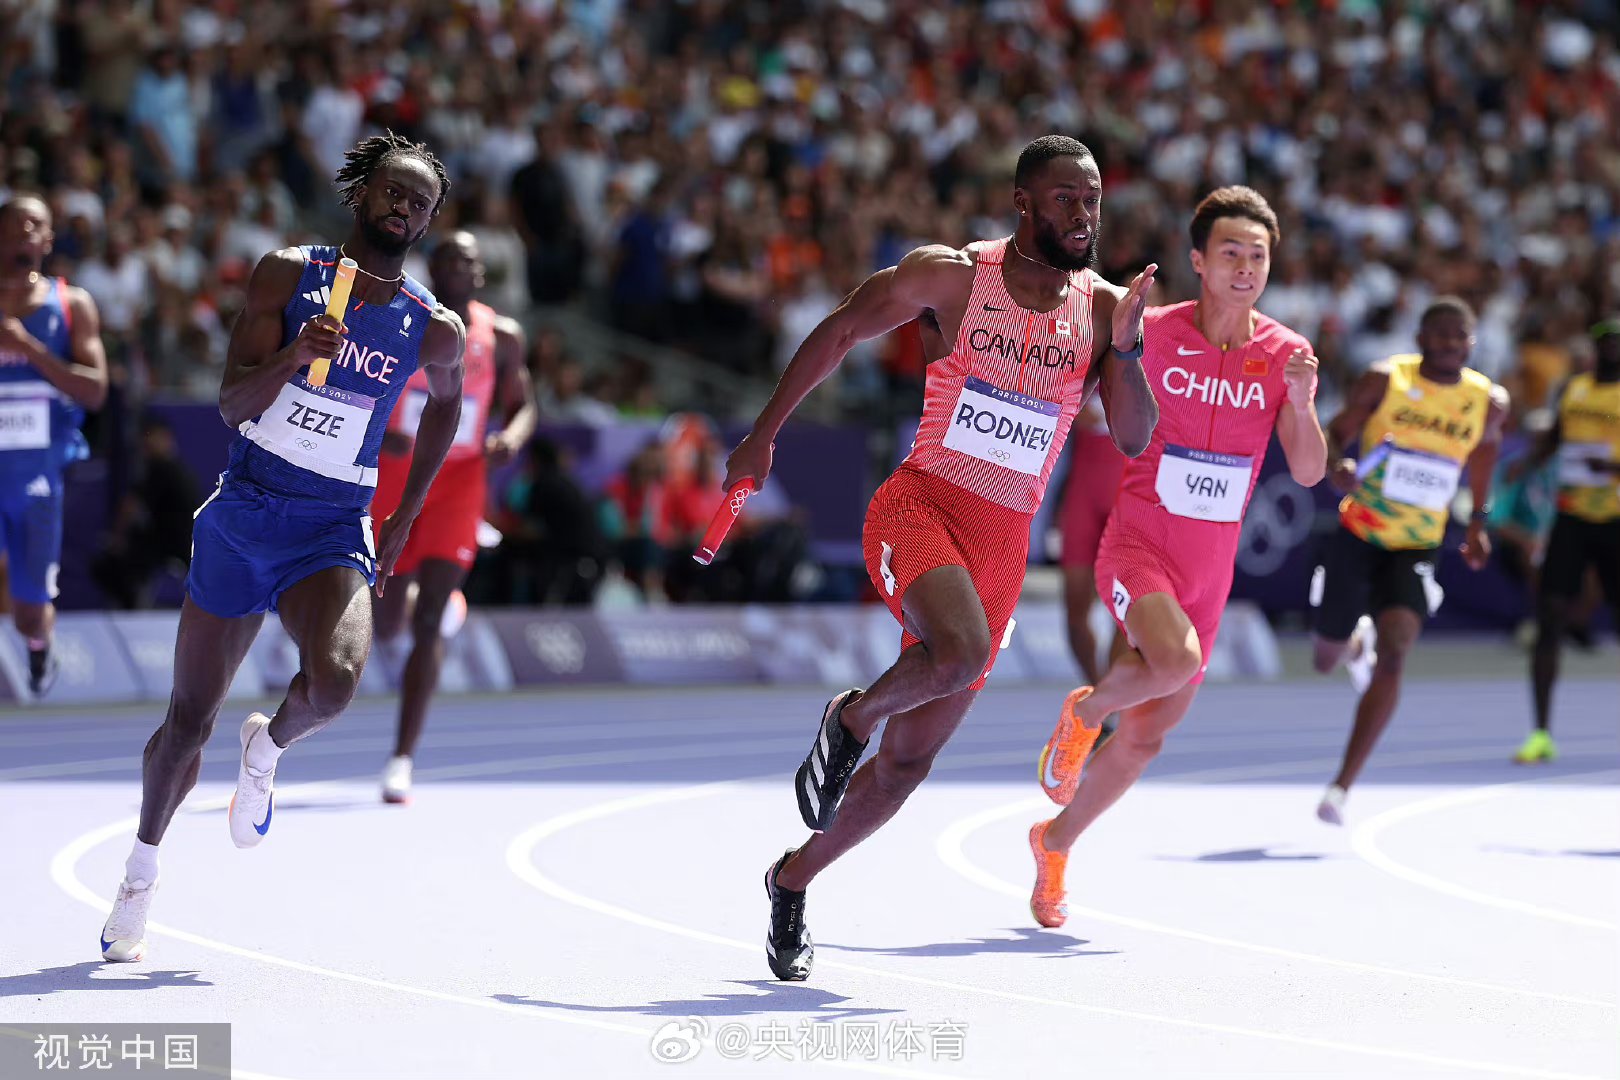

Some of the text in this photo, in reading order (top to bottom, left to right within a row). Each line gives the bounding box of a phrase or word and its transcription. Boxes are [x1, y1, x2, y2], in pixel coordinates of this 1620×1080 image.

[298, 322, 399, 385] NCE
[970, 328, 1076, 373] CANADA
[991, 388, 1045, 410] PARIS 2024
[1162, 366, 1266, 410] CHINA
[286, 400, 344, 438] ZEZE
[956, 402, 1053, 452] RODNEY
[1186, 473, 1228, 498] YAN
